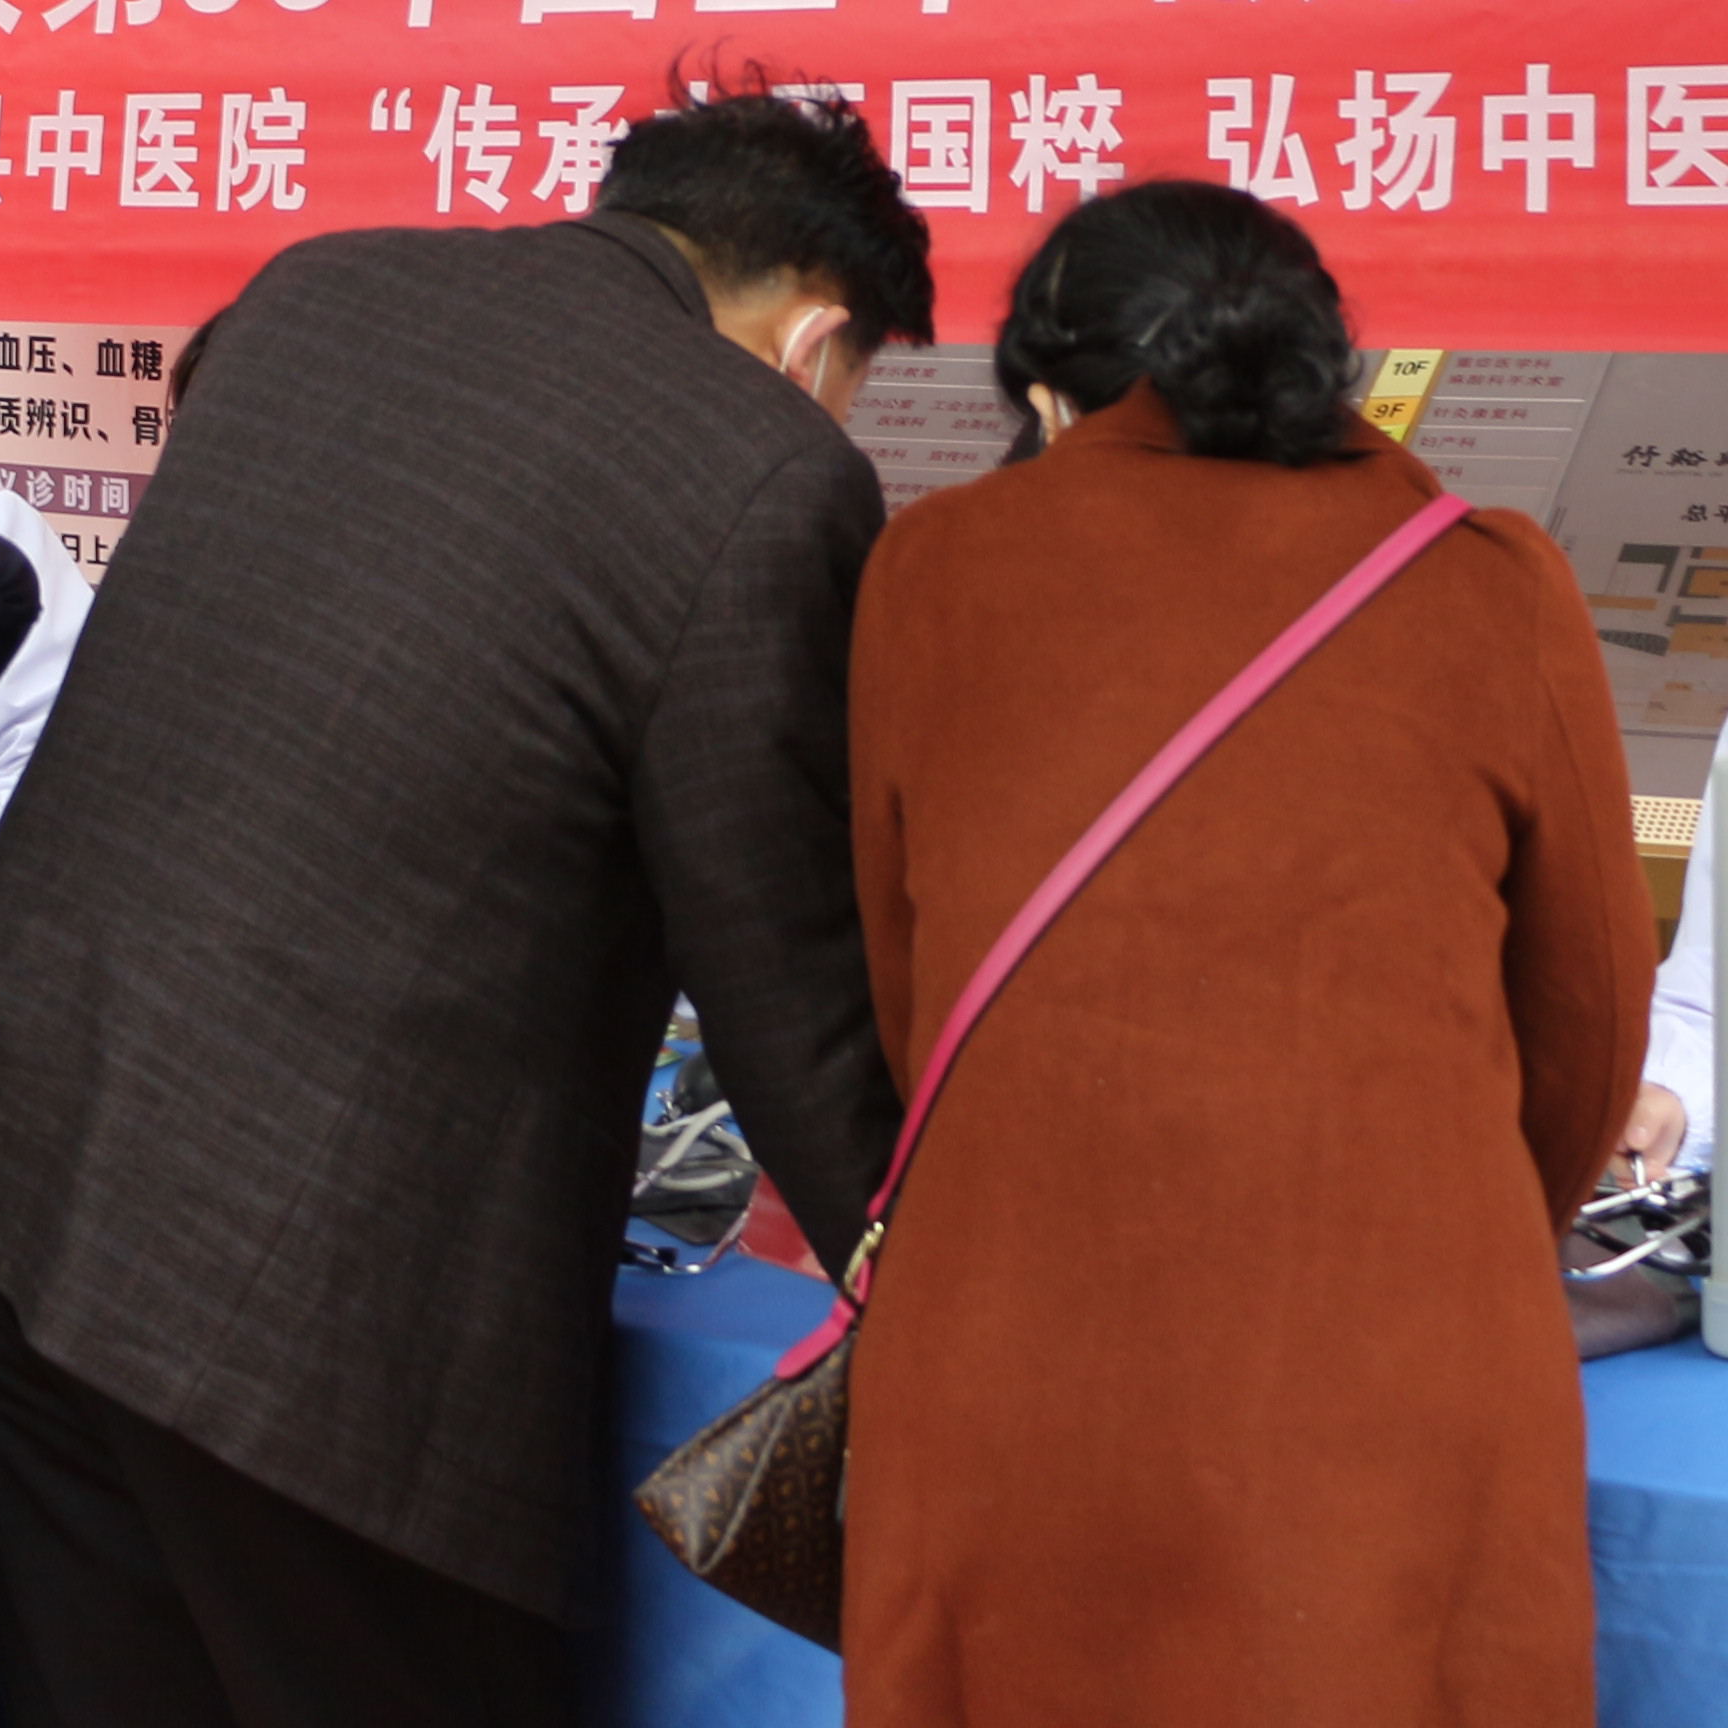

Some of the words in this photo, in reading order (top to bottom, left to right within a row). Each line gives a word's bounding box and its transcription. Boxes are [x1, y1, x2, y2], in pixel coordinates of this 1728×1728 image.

[369, 72, 1125, 215] “传承国粹
[1391, 360, 1430, 377] 10F
[1373, 402, 1406, 420] 9F
